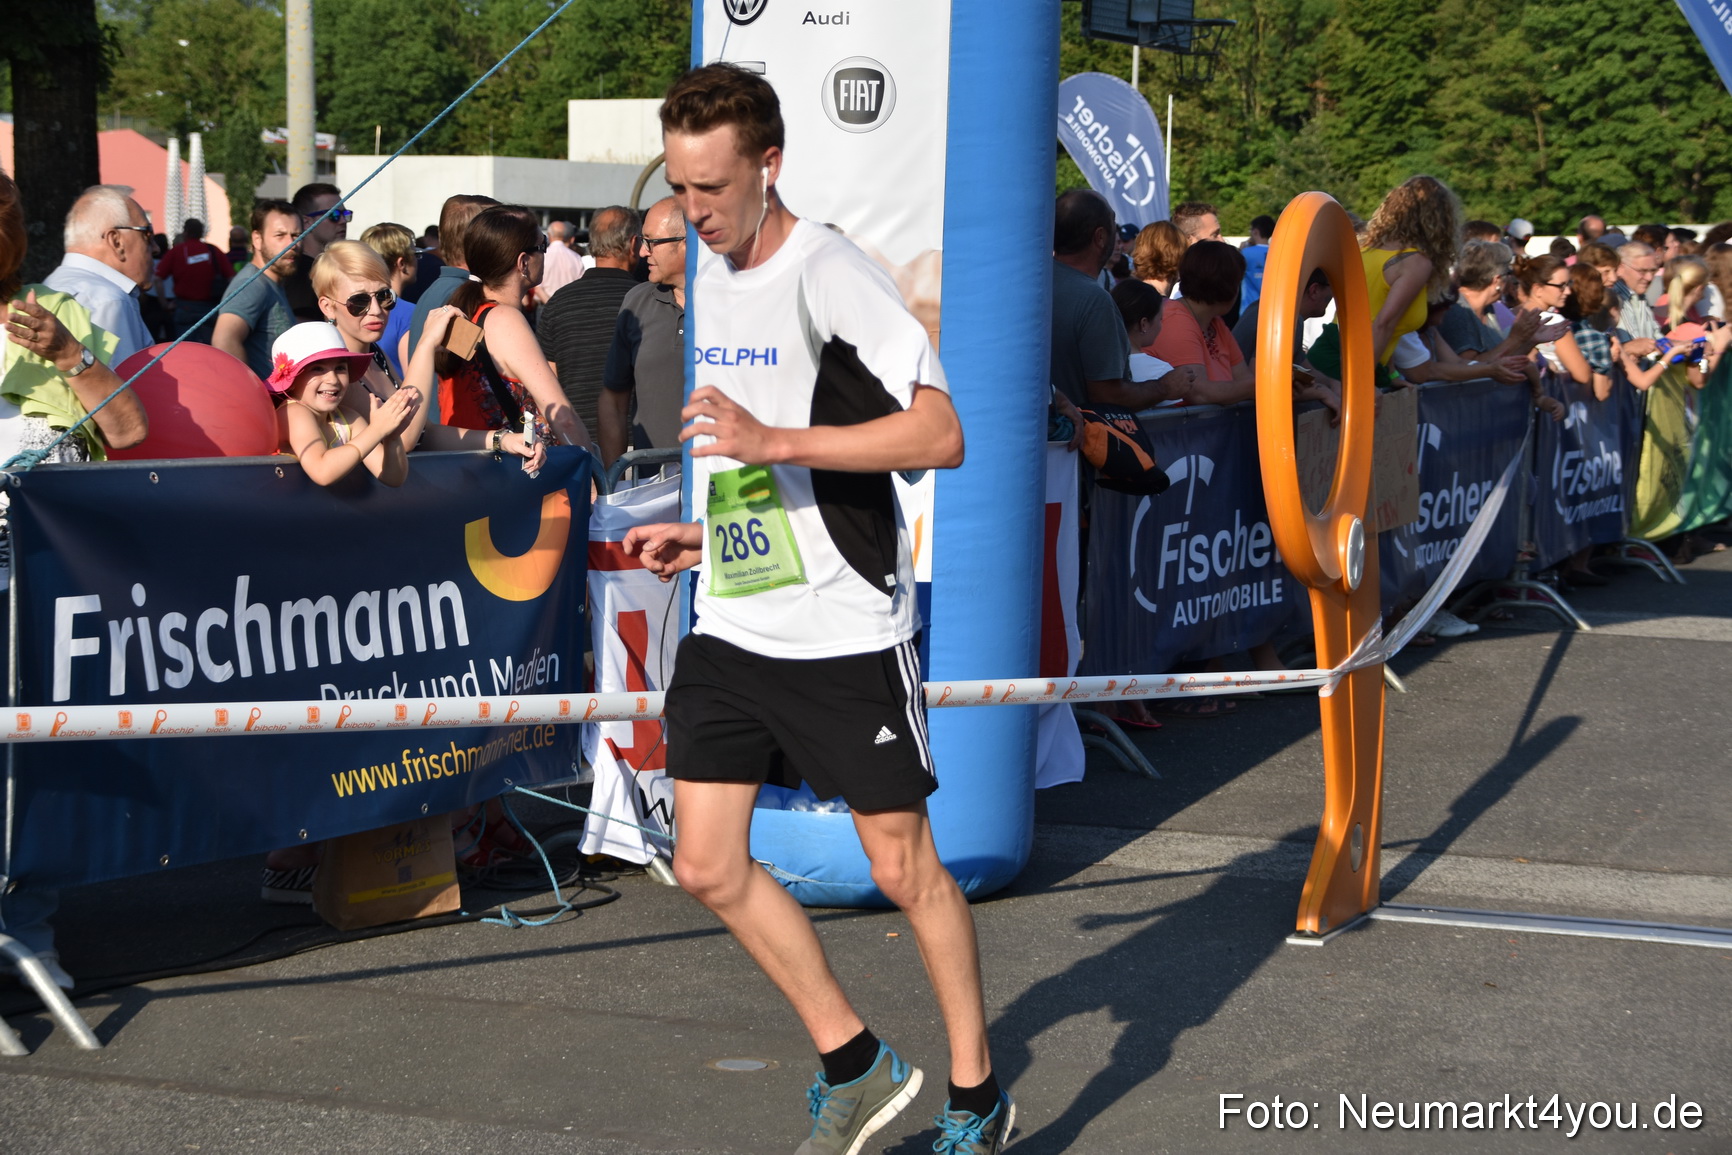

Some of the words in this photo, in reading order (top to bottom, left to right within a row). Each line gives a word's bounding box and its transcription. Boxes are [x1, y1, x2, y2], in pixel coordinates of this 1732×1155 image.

[801, 11, 850, 26] Audi
[839, 79, 880, 112] FIAT
[1560, 441, 1623, 499] Fische
[715, 517, 771, 564] 286
[1158, 509, 1282, 590] Fische
[1172, 577, 1283, 628] AUTOMOBILE
[53, 574, 470, 703] Frischmann
[319, 671, 409, 700] Druck
[419, 659, 482, 699] und
[489, 649, 560, 696] Medien
[331, 723, 556, 798] www.frischmann-net.de
[874, 733, 897, 744] adidas
